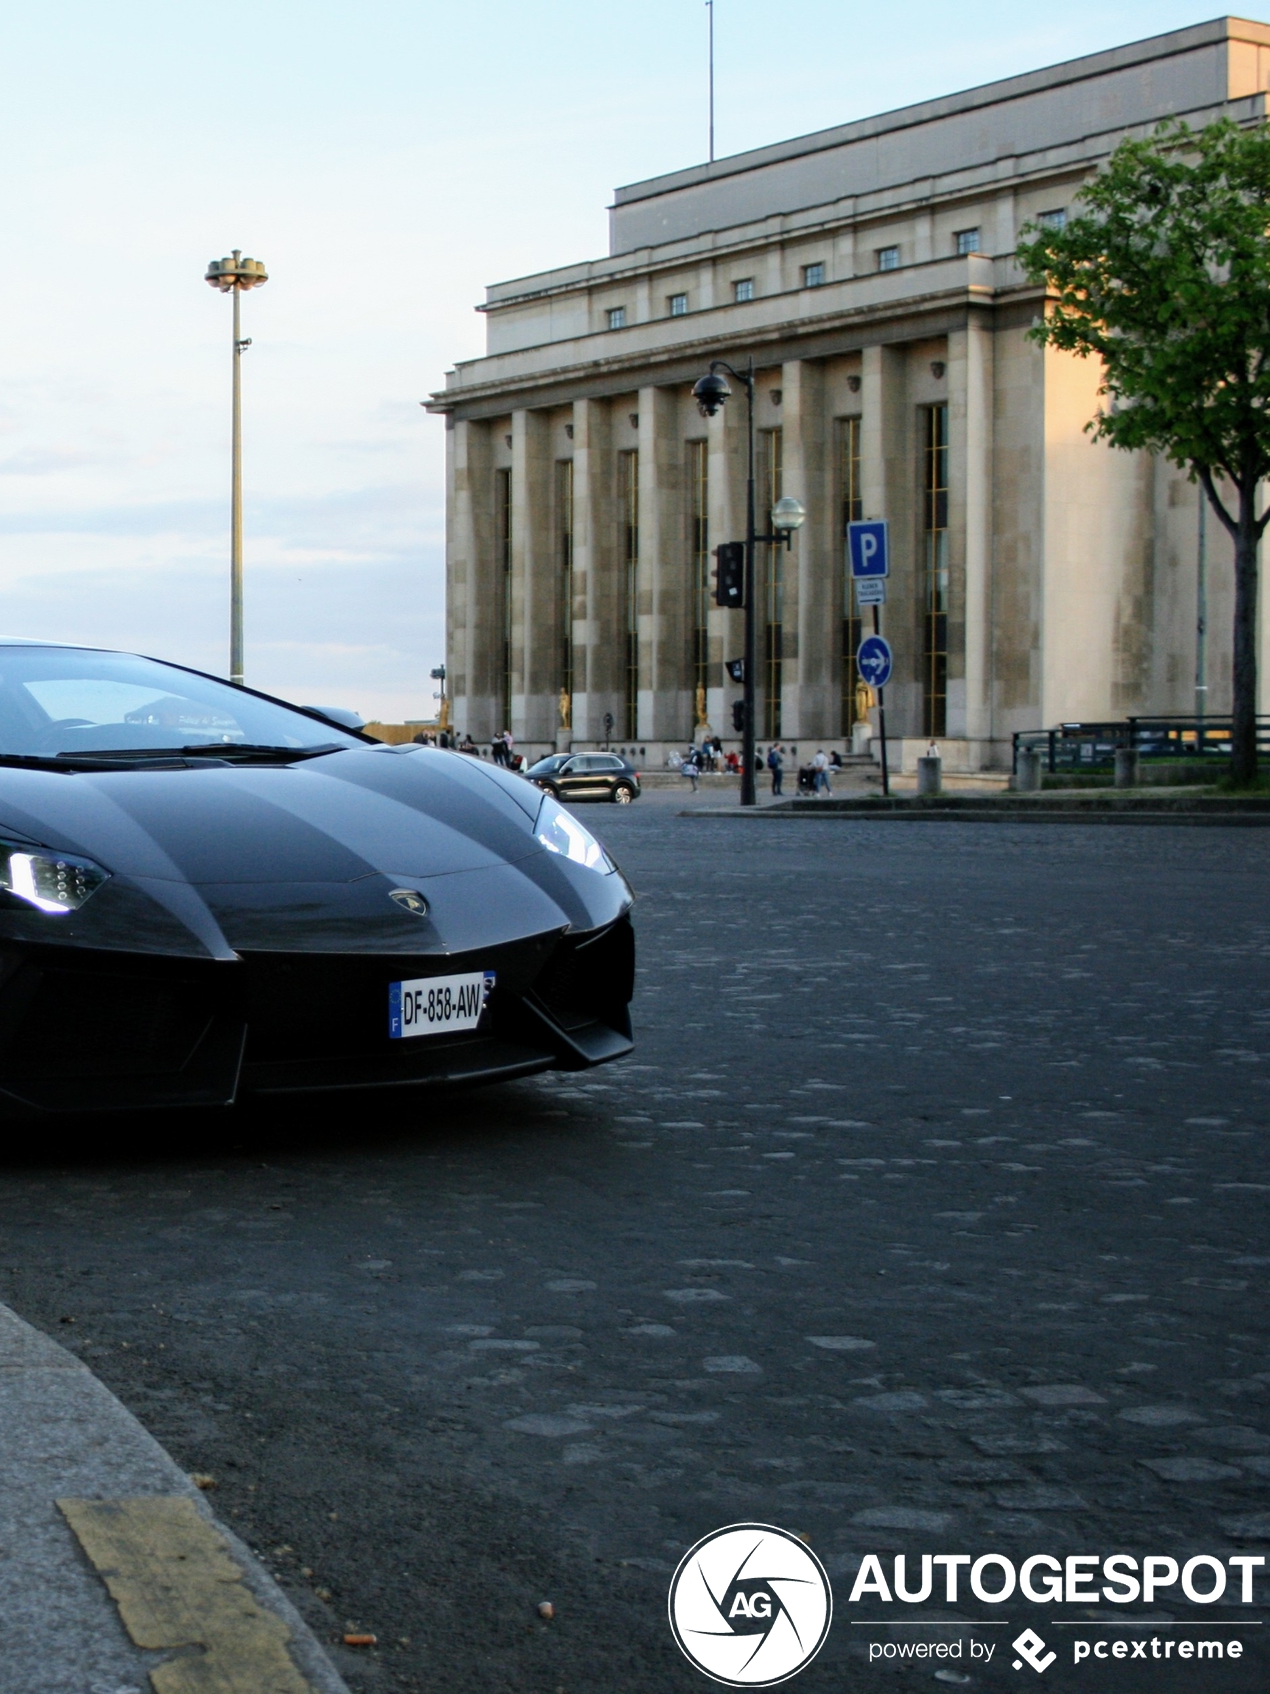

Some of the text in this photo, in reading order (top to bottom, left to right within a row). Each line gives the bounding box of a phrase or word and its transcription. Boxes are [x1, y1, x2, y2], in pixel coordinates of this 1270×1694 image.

[861, 533, 877, 567] P
[404, 984, 480, 1025] DF-858-AW
[392, 1018, 398, 1032] F
